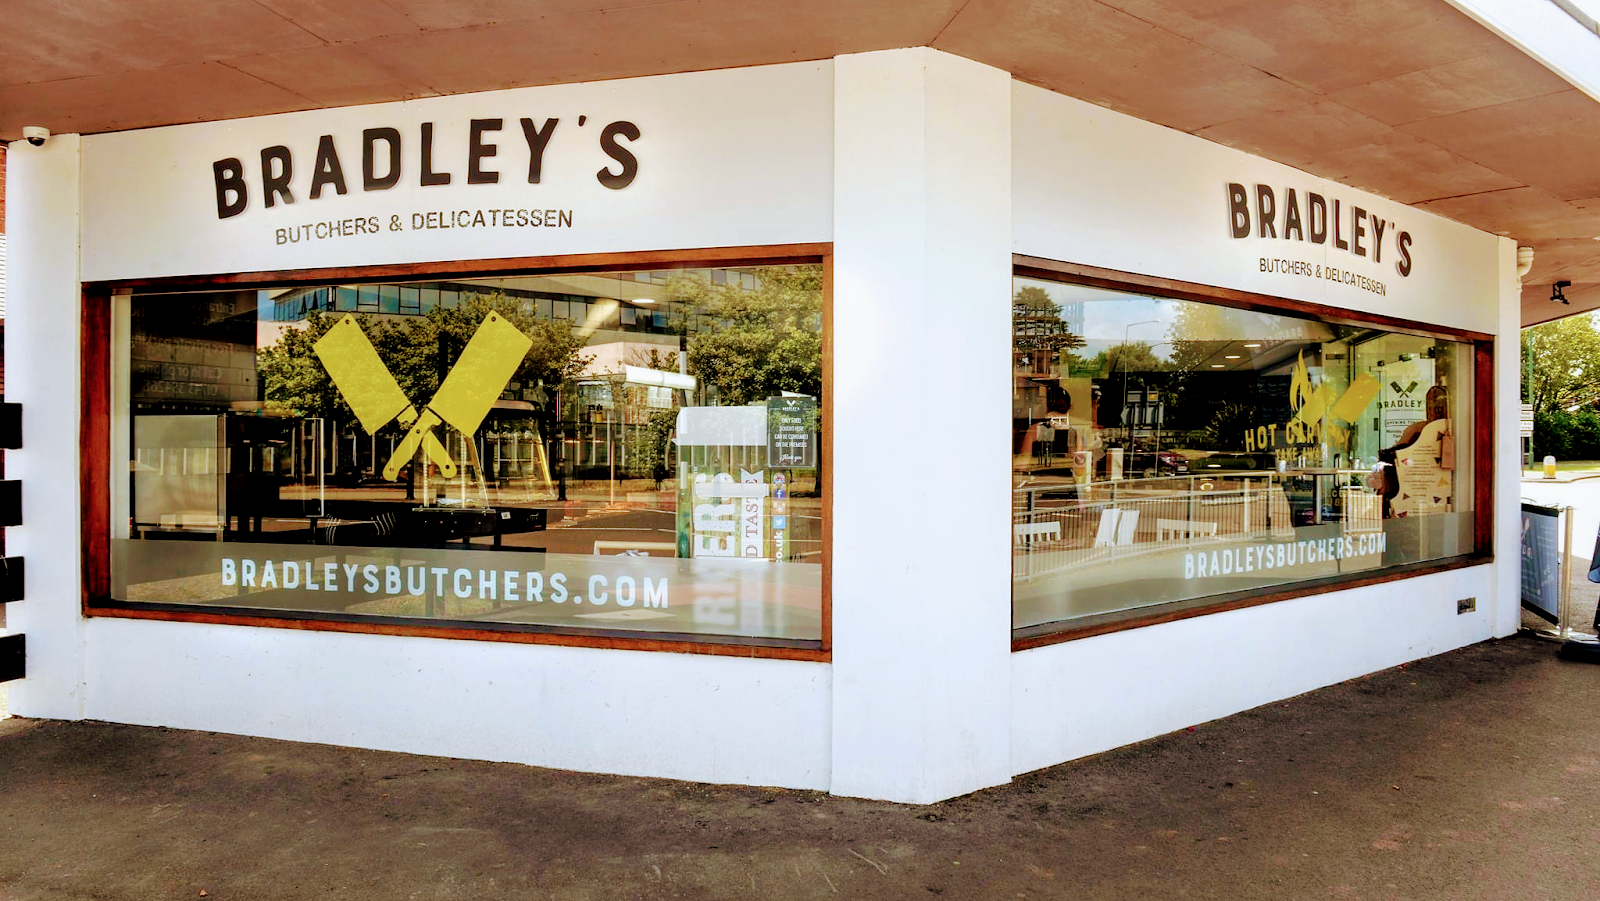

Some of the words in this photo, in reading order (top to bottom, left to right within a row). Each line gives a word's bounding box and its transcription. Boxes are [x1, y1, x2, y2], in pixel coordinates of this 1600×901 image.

[213, 115, 641, 219] BRADLEY'S
[275, 216, 380, 245] BUTCHERS
[389, 219, 402, 232] &
[411, 209, 573, 231] DELICATESSEN
[1228, 183, 1412, 277] BRADLEY'S
[1259, 258, 1312, 277] BUTCHERS
[1315, 265, 1322, 278] &
[1325, 266, 1386, 297] DELICATESSEN
[1245, 423, 1277, 453] HOT
[1275, 447, 1298, 461] TAKE
[1184, 532, 1386, 579] BRADLEYSBUTCHERS.COM
[221, 558, 669, 608] BRADLEYSBUTCHERS.COM
